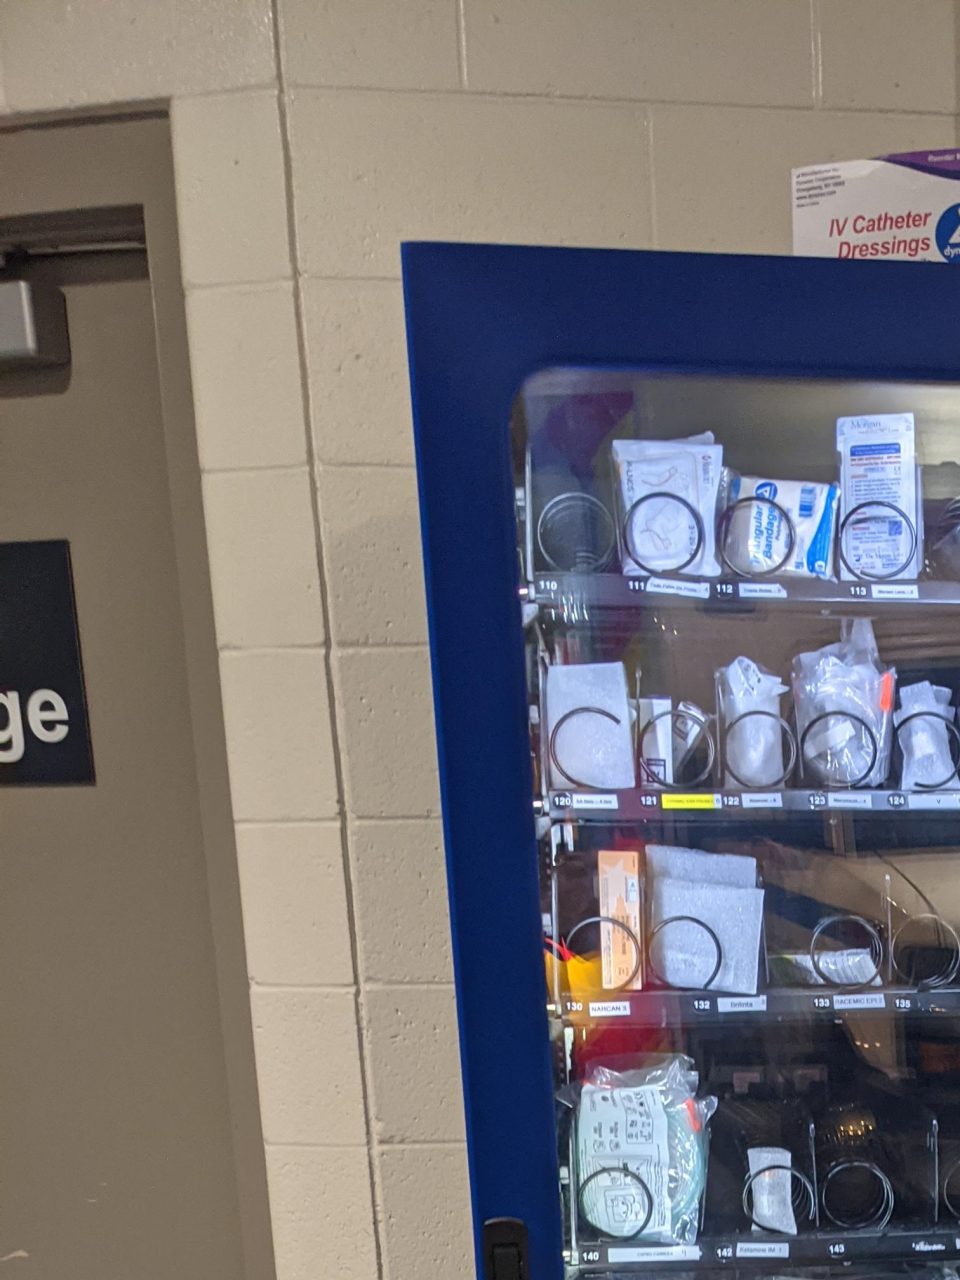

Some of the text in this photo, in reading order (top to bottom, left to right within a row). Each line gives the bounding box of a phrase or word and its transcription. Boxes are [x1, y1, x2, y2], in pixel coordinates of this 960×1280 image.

[828, 210, 933, 238] IV Catheter
[838, 235, 932, 260] Dressings
[763, 506, 777, 559] Bandage
[539, 580, 558, 591] 110
[628, 580, 644, 590] 111
[716, 584, 733, 593] 112
[849, 586, 866, 596] 113
[0, 688, 69, 763] ge
[554, 796, 570, 806] 120
[640, 796, 657, 805] 121
[724, 796, 740, 805] 122
[809, 796, 826, 805] 123
[889, 796, 905, 805] 124
[693, 1000, 710, 1010] 132
[813, 998, 830, 1008] 133
[834, 996, 863, 1006] RACEMIC
[567, 1002, 583, 1011] 130
[591, 1004, 622, 1014] NARCAN
[828, 1243, 845, 1255] 143
[582, 1252, 599, 1262] 140
